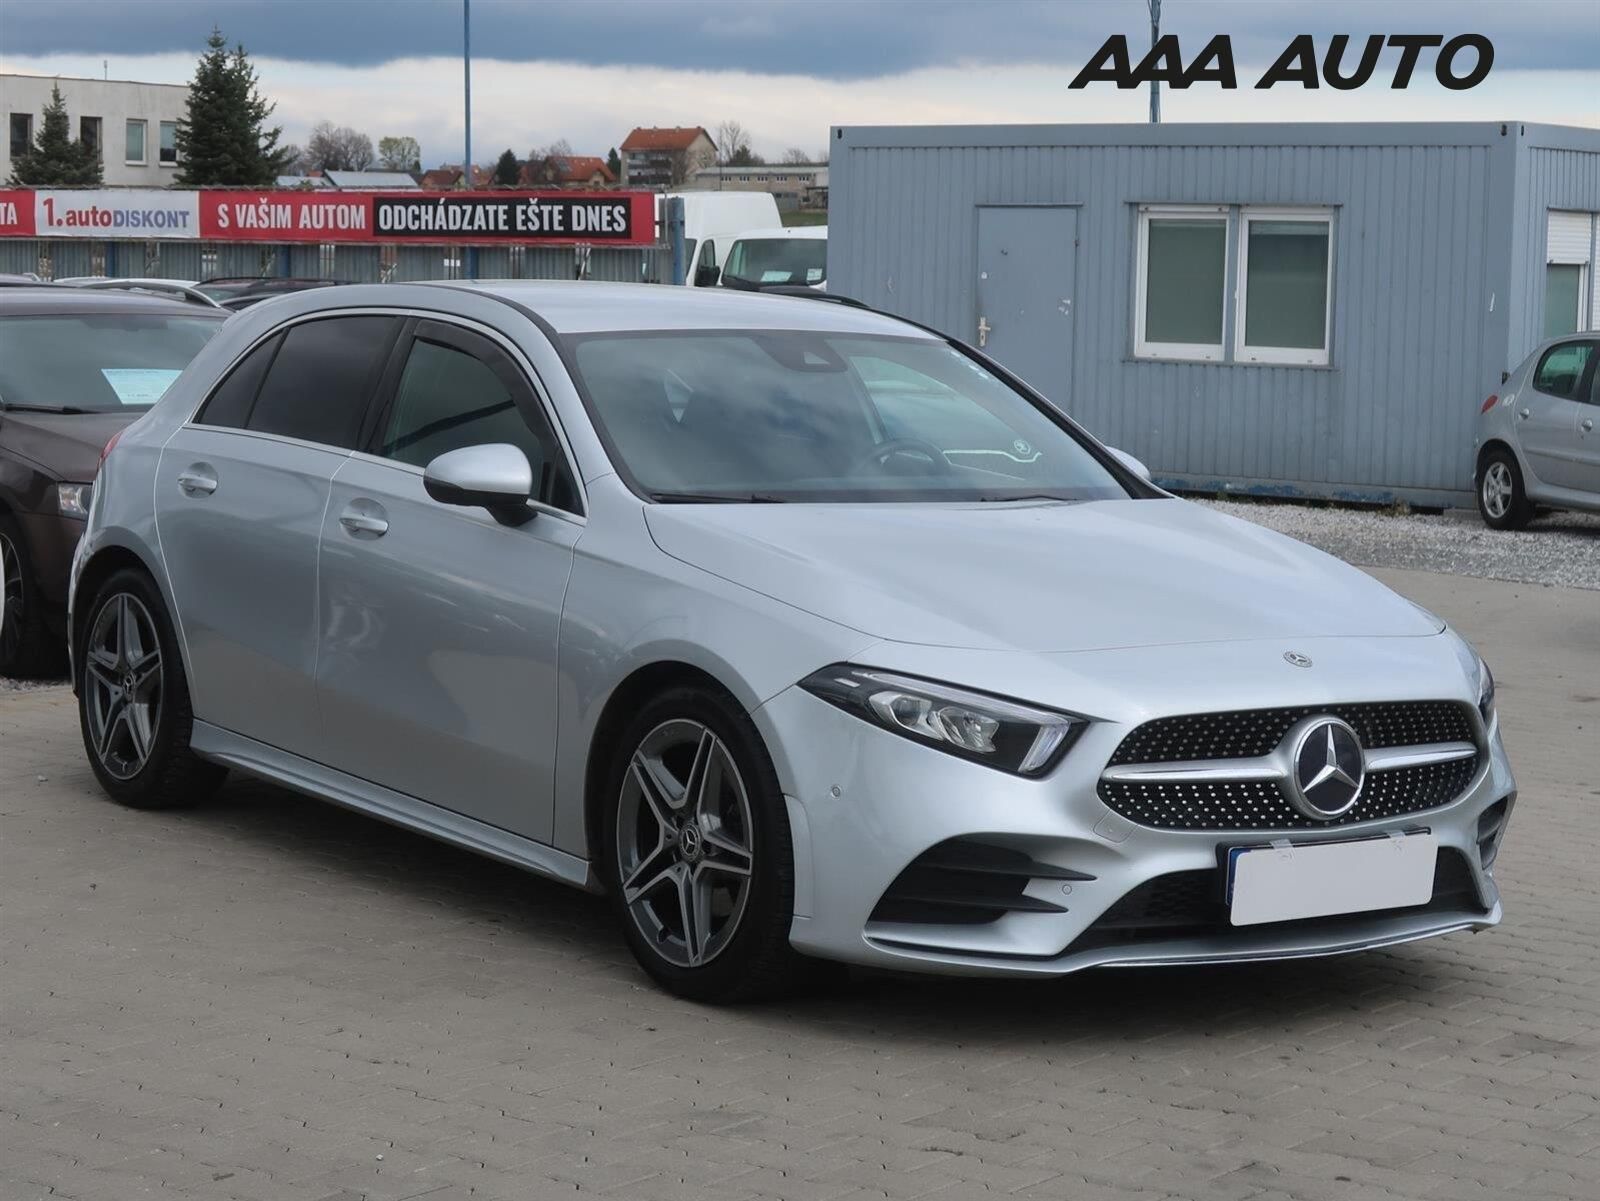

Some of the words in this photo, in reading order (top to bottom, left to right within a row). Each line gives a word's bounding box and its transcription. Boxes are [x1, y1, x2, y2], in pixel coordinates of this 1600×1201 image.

[217, 204, 229, 228] S
[235, 197, 291, 229] VAŠIM
[300, 204, 365, 229] AUTOM
[378, 197, 508, 231] ODCHÁDZATE
[515, 197, 564, 231] EŠTE
[571, 205, 626, 232] DNES
